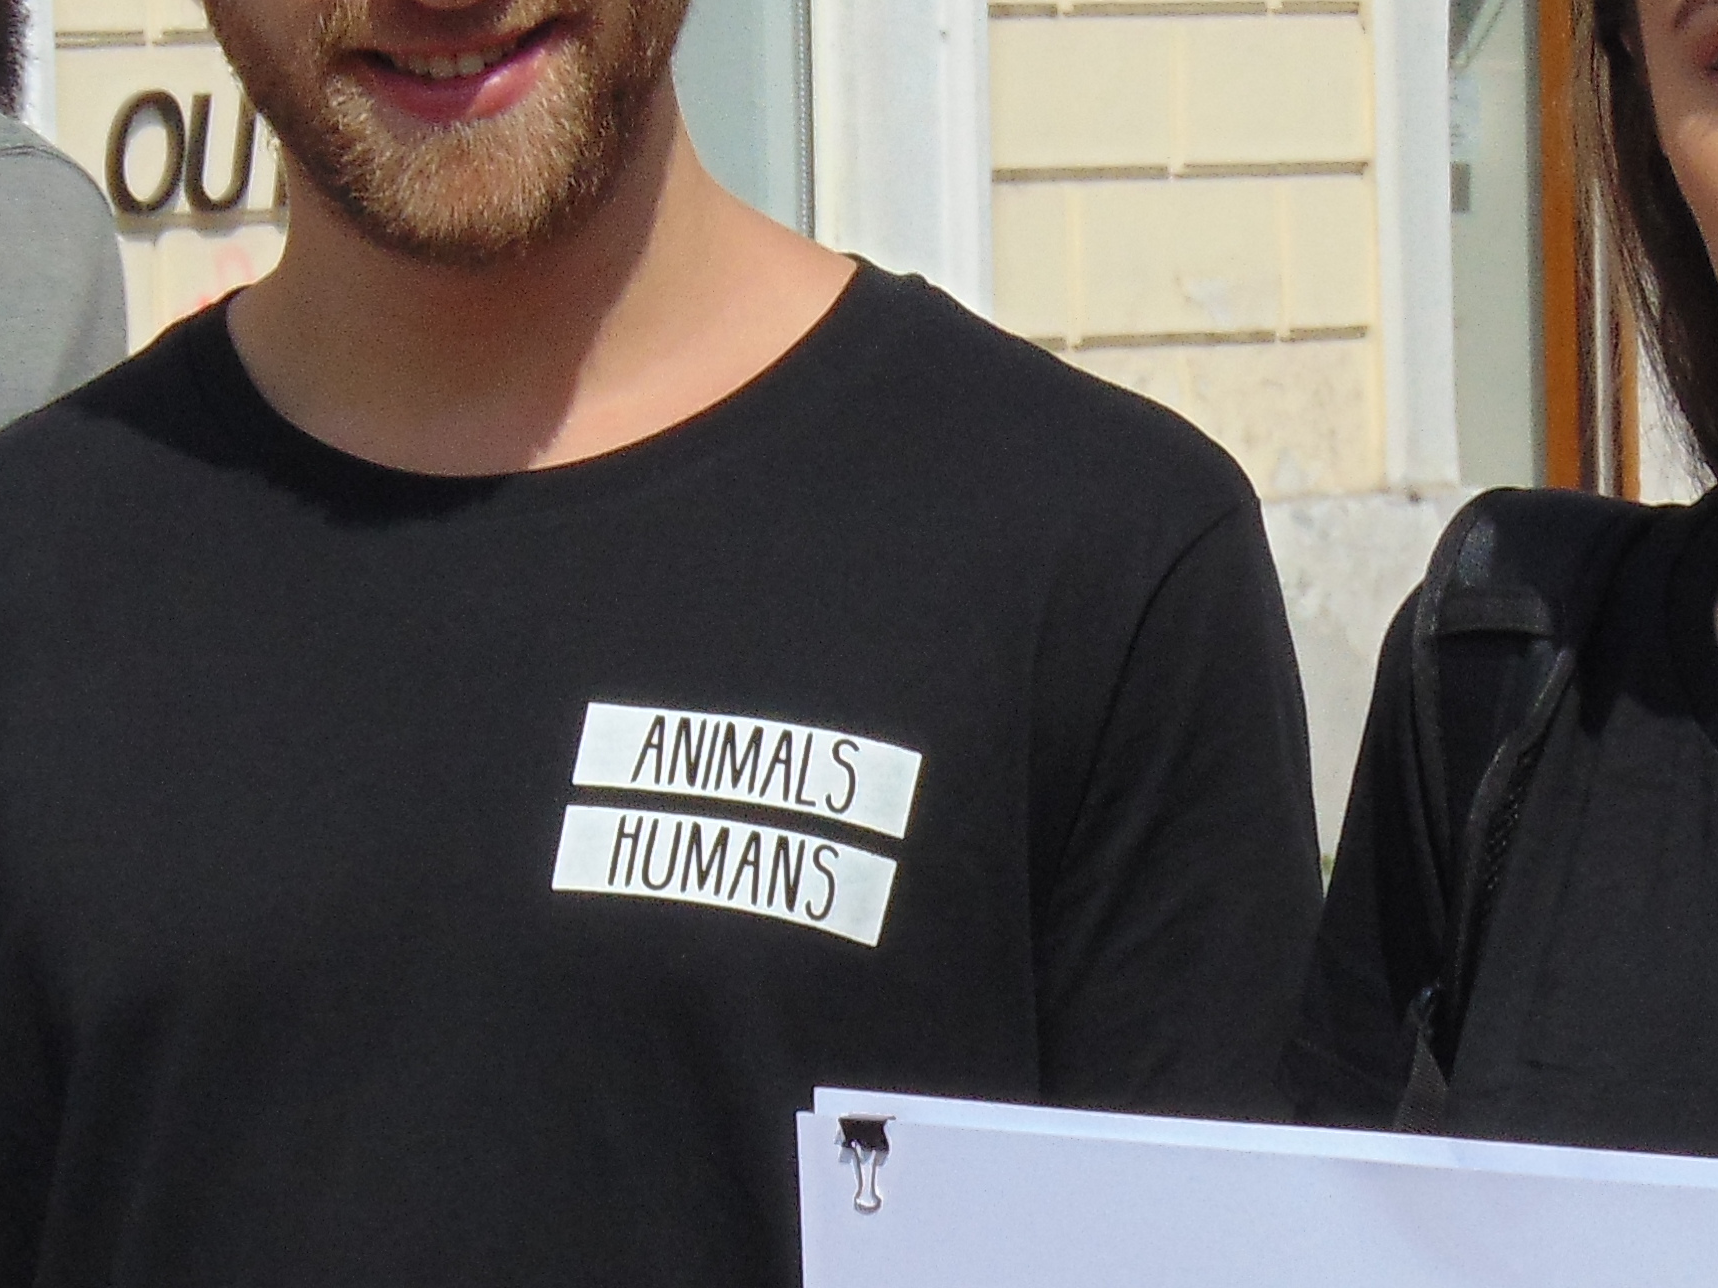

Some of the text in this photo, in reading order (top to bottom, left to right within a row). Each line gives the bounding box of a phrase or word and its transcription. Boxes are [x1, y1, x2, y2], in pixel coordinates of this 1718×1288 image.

[105, 88, 287, 212] OU
[629, 714, 861, 814] ANIMALS
[606, 813, 841, 922] HUMANS
